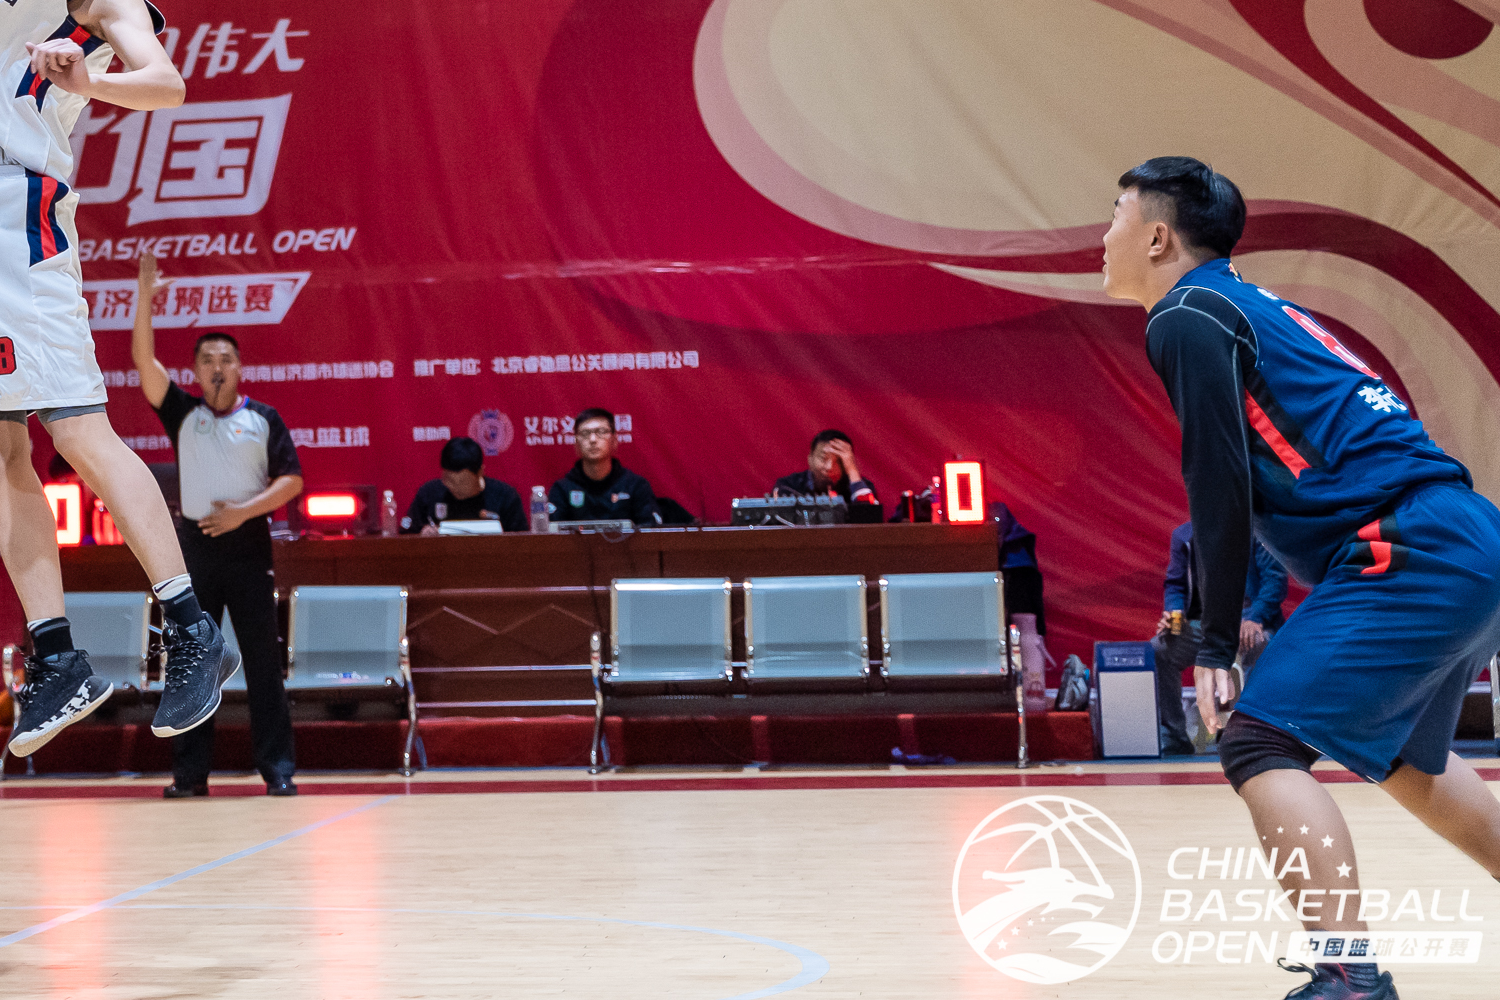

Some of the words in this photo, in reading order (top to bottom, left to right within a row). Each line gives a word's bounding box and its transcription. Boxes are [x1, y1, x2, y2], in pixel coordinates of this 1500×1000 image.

[78, 232, 258, 263] BASKETBALL
[272, 227, 357, 252] OPEN
[945, 461, 985, 522] 0
